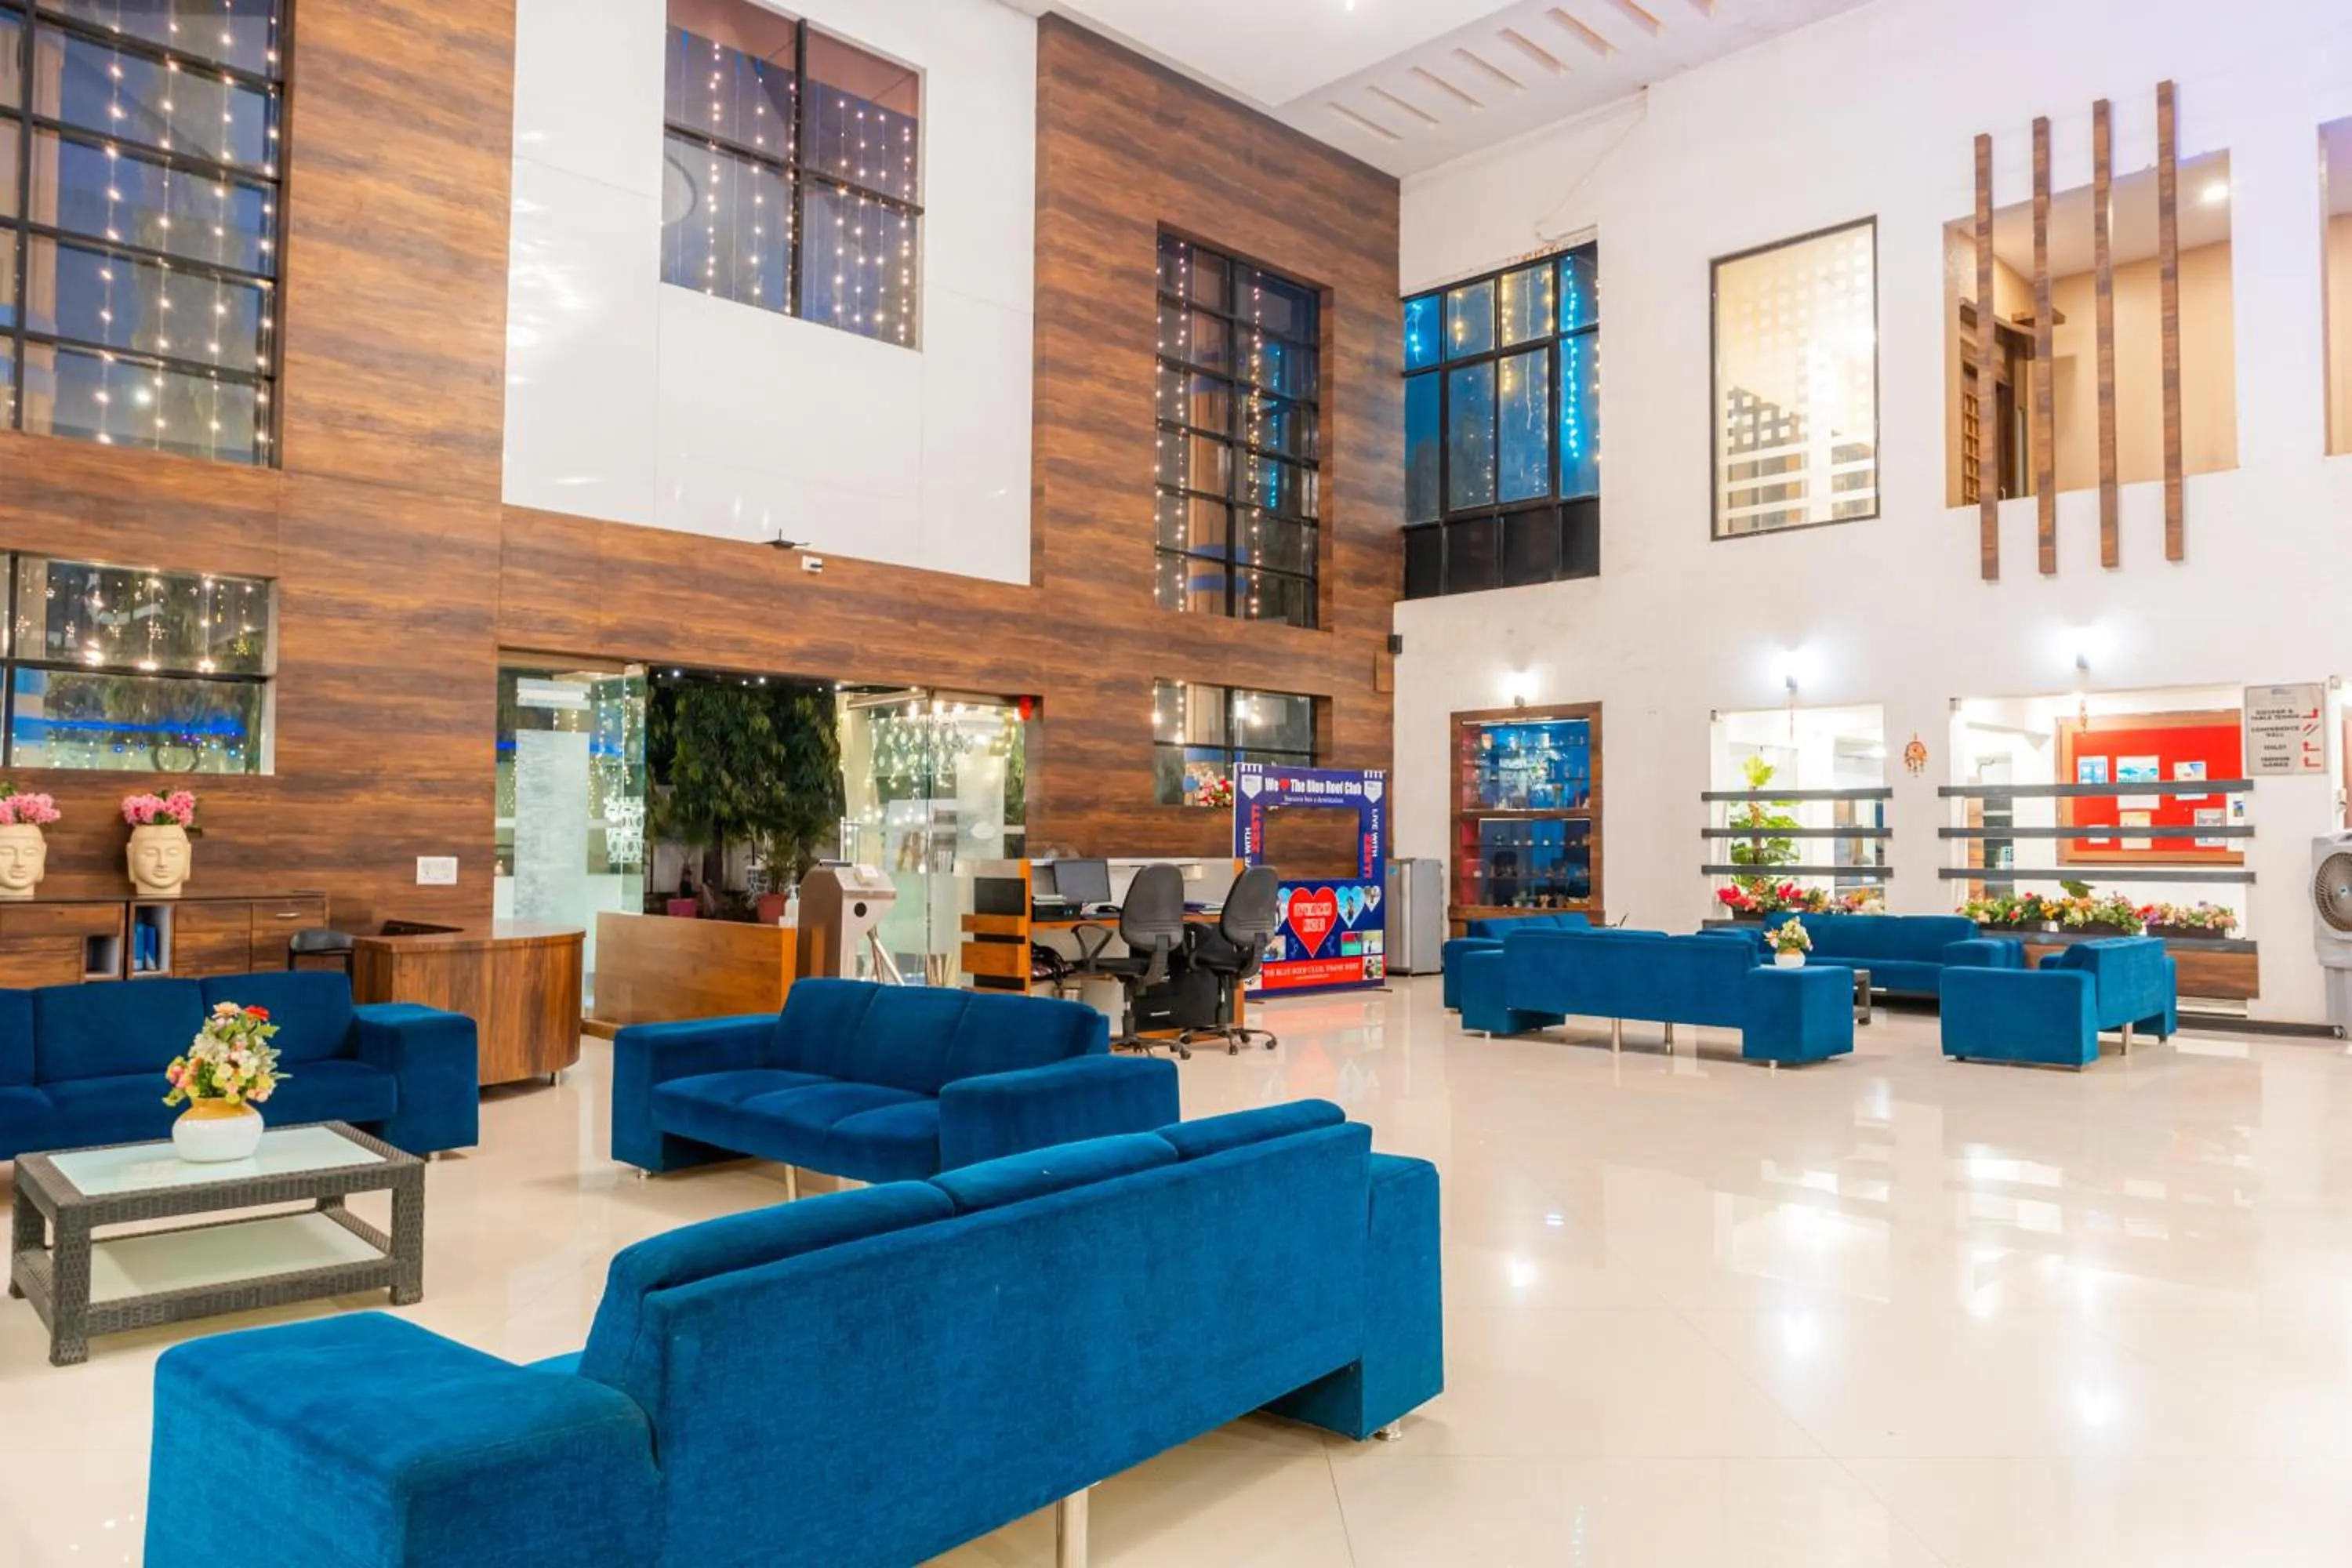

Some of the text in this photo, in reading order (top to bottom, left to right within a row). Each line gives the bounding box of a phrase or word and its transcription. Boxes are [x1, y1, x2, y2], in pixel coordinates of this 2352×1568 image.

[1265, 777, 1279, 792] We
[1290, 779, 1305, 793] The
[1307, 779, 1324, 794] Blue
[1326, 779, 1344, 794] Roof
[1345, 781, 1362, 796] Club
